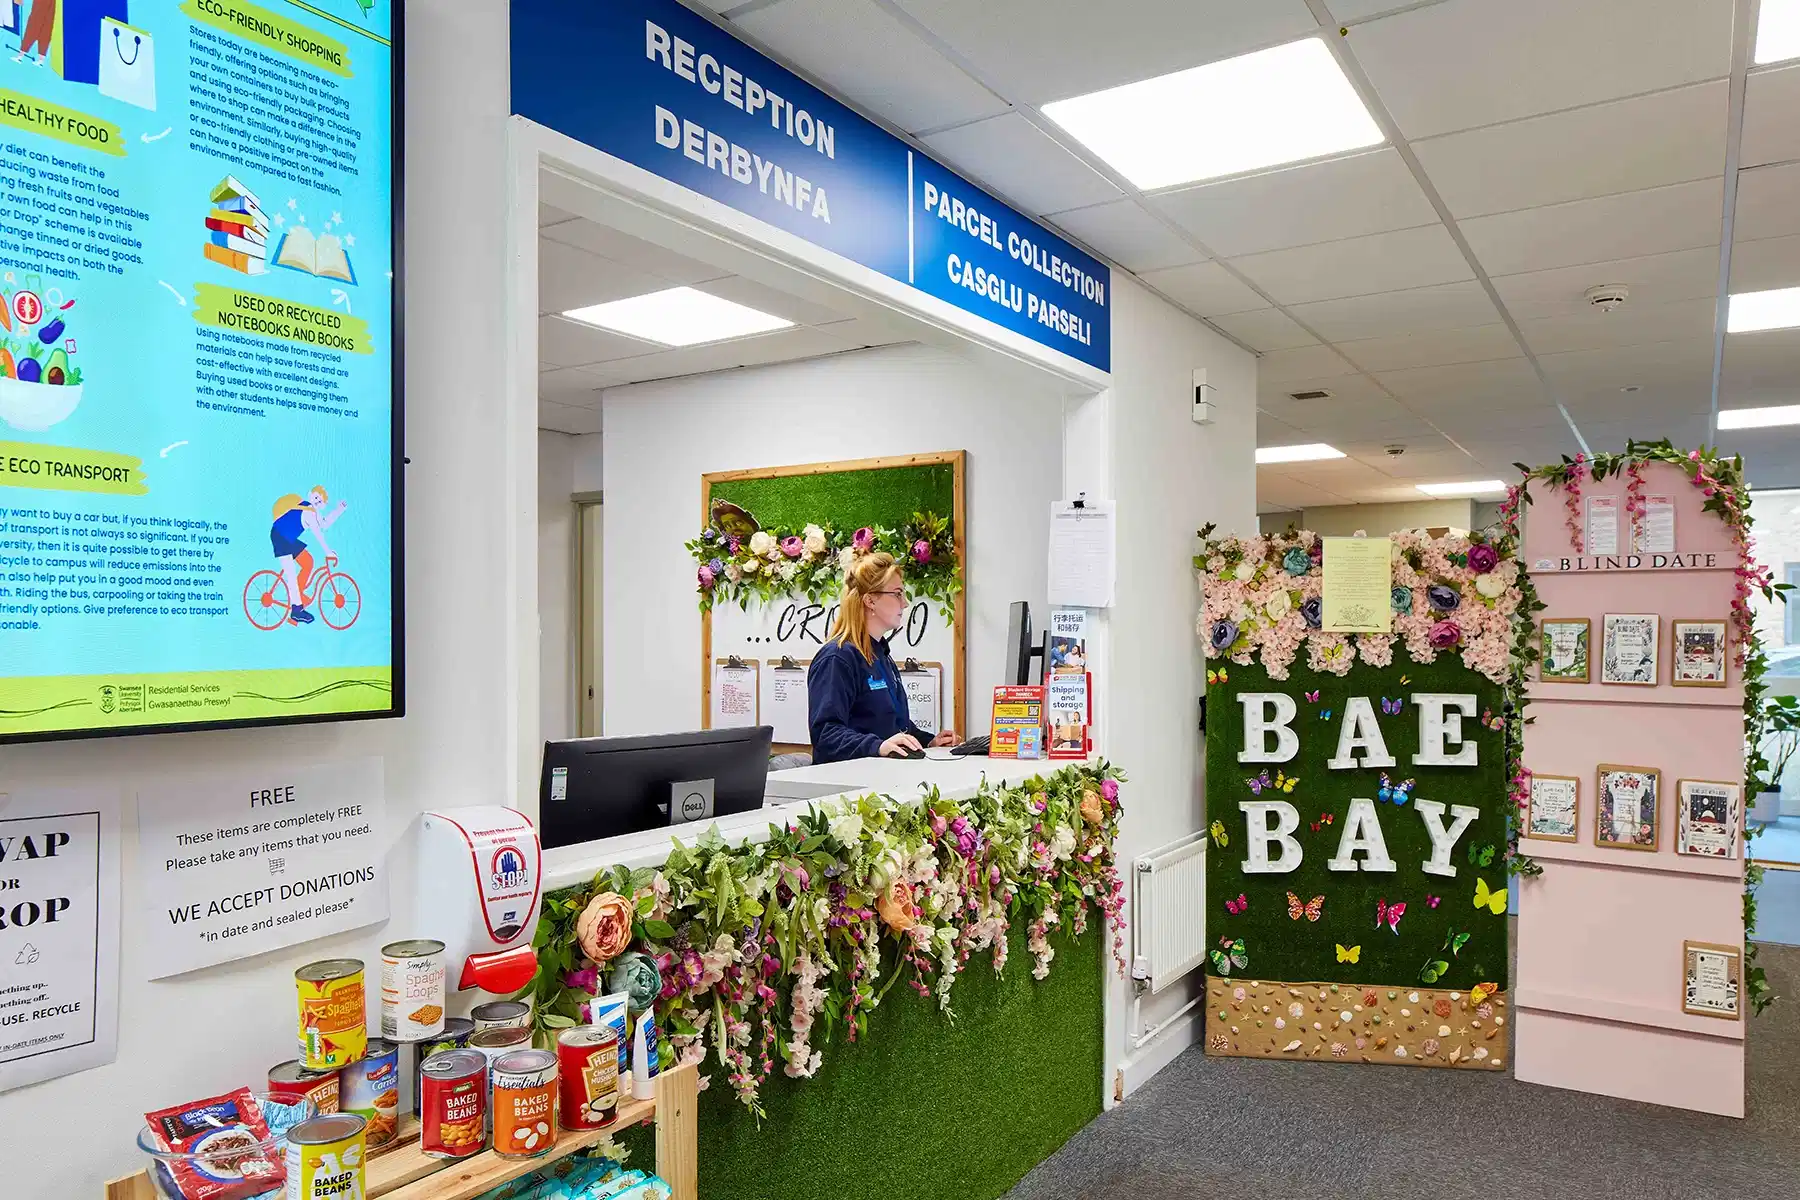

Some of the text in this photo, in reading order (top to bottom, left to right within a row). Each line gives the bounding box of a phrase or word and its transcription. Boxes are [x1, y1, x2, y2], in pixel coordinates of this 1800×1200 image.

[197, 0, 341, 66] ECO-FRIENDLY SHOPPING
[189, 23, 217, 42] Stores
[217, 34, 243, 56] today
[243, 47, 258, 58] are
[259, 50, 299, 77] becoming
[299, 68, 320, 82] more
[645, 20, 835, 160] RECEPTION
[0, 99, 109, 143] HEALTHY FOOD
[5, 141, 105, 179] diet can benefit the
[189, 142, 244, 166] environment
[244, 160, 287, 179] compared
[287, 171, 296, 182] to
[296, 173, 312, 187] fast
[655, 104, 831, 225] DERBYNFA
[17, 177, 149, 221] fresh fruits and vegetables
[35, 230, 69, 248] tinned
[70, 241, 82, 251] or
[83, 241, 110, 257] dried
[923, 181, 1104, 307] PARCEL COLLECTION
[947, 253, 1091, 346] CASGLU PARSELI
[233, 294, 341, 329] USED OR RECYCLED
[218, 311, 354, 351] NOTEBOOKS AND BOOKS
[195, 369, 348, 403] Buying used books or exchanging them
[195, 398, 211, 410] the
[9, 457, 130, 483] ECO TRANSPORT
[1559, 555, 1641, 571] BLIND
[1652, 553, 1717, 569] DATE
[15, 586, 48, 602] Riding
[50, 586, 68, 598] the
[92, 588, 144, 603] carpooling
[145, 591, 156, 600] or
[156, 588, 186, 604] taking
[187, 589, 202, 600] the
[203, 589, 223, 601] train
[82, 603, 105, 614] Give
[107, 603, 158, 618] preference
[159, 603, 169, 615] to
[170, 607, 188, 615] eco
[188, 604, 228, 619] transport
[148, 683, 220, 695] Residential Services
[907, 682, 920, 690] KEY
[1052, 686, 1085, 695] Shipping
[907, 693, 932, 703] ARGES
[1052, 701, 1084, 710] storage
[1236, 691, 1478, 771] BAE
[250, 785, 295, 808] FREE
[684, 803, 703, 811] DELL
[176, 805, 362, 847] These items are completely FREE
[1237, 796, 1480, 877] BAY
[0, 832, 70, 863] AP
[166, 823, 372, 871] Please take any items that you need.
[491, 869, 528, 890] STOP!
[168, 866, 375, 925] WE ACCEPT DONATIONS
[0, 897, 70, 930] OP
[221, 924, 249, 940] date
[251, 916, 274, 932] and
[276, 907, 312, 927] sealed
[0, 985, 31, 995] ething
[405, 984, 439, 999] Loops
[0, 997, 32, 1009] ething
[32, 1001, 81, 1021] RECYCLE
[29, 1036, 48, 1045] ITEMS
[48, 1032, 65, 1041] ONLY
[498, 1072, 546, 1091] Essentials
[446, 1092, 478, 1109] BAKED
[514, 1093, 549, 1107] BAKED
[514, 1102, 549, 1117] BEANS
[447, 1104, 478, 1121] BEANS
[314, 1171, 353, 1188] BAKED
[314, 1181, 352, 1197] BEANS
